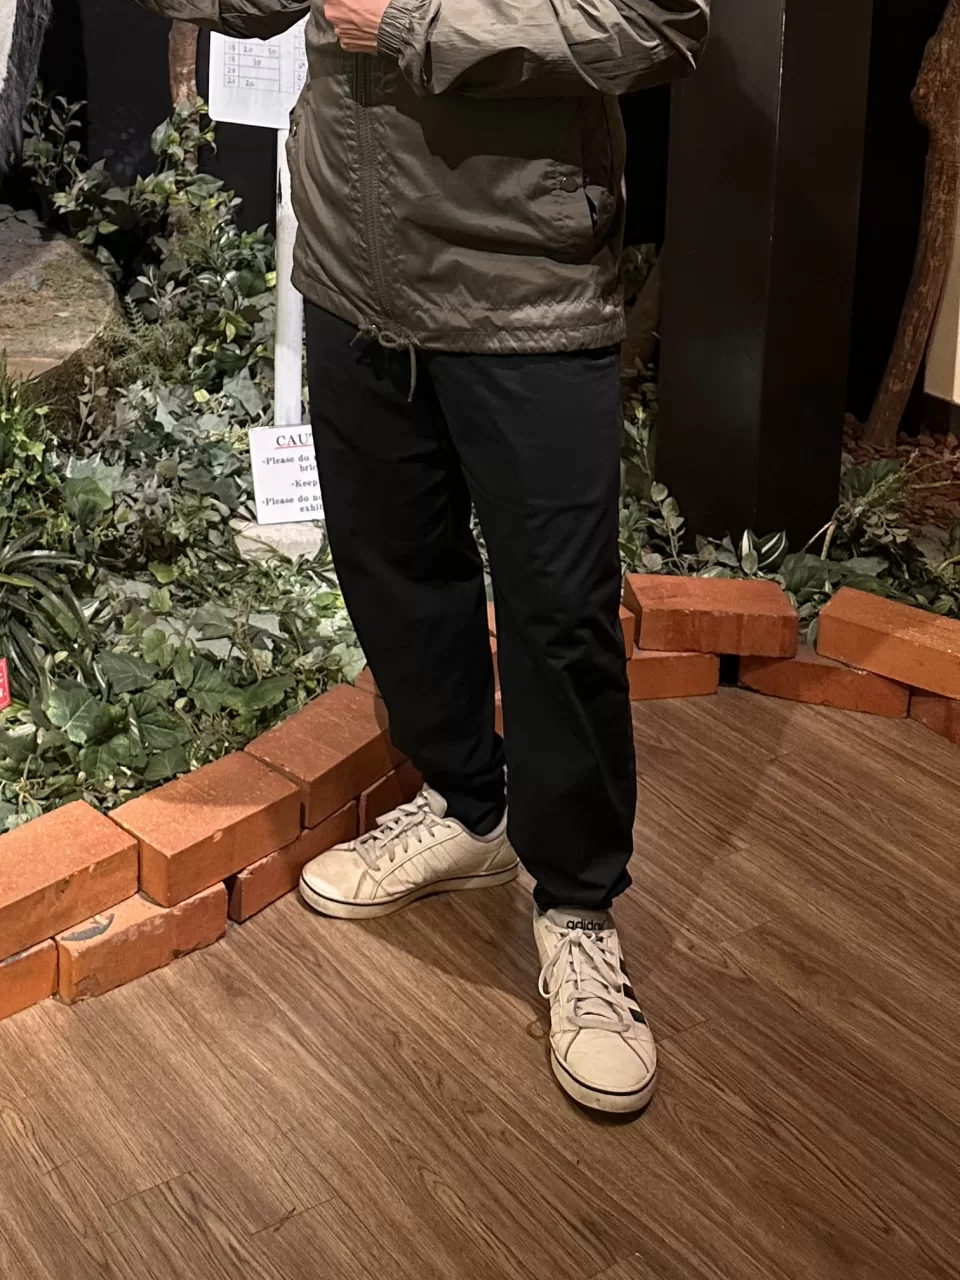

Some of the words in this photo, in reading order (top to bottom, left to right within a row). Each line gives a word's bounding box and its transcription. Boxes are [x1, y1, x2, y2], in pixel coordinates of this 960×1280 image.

[242, 45, 254, 53] 20
[252, 57, 262, 66] 30
[244, 79, 255, 87] 20
[276, 432, 313, 447] CAU
[298, 454, 310, 462] do
[298, 494, 310, 502] do
[566, 918, 606, 931] adida
